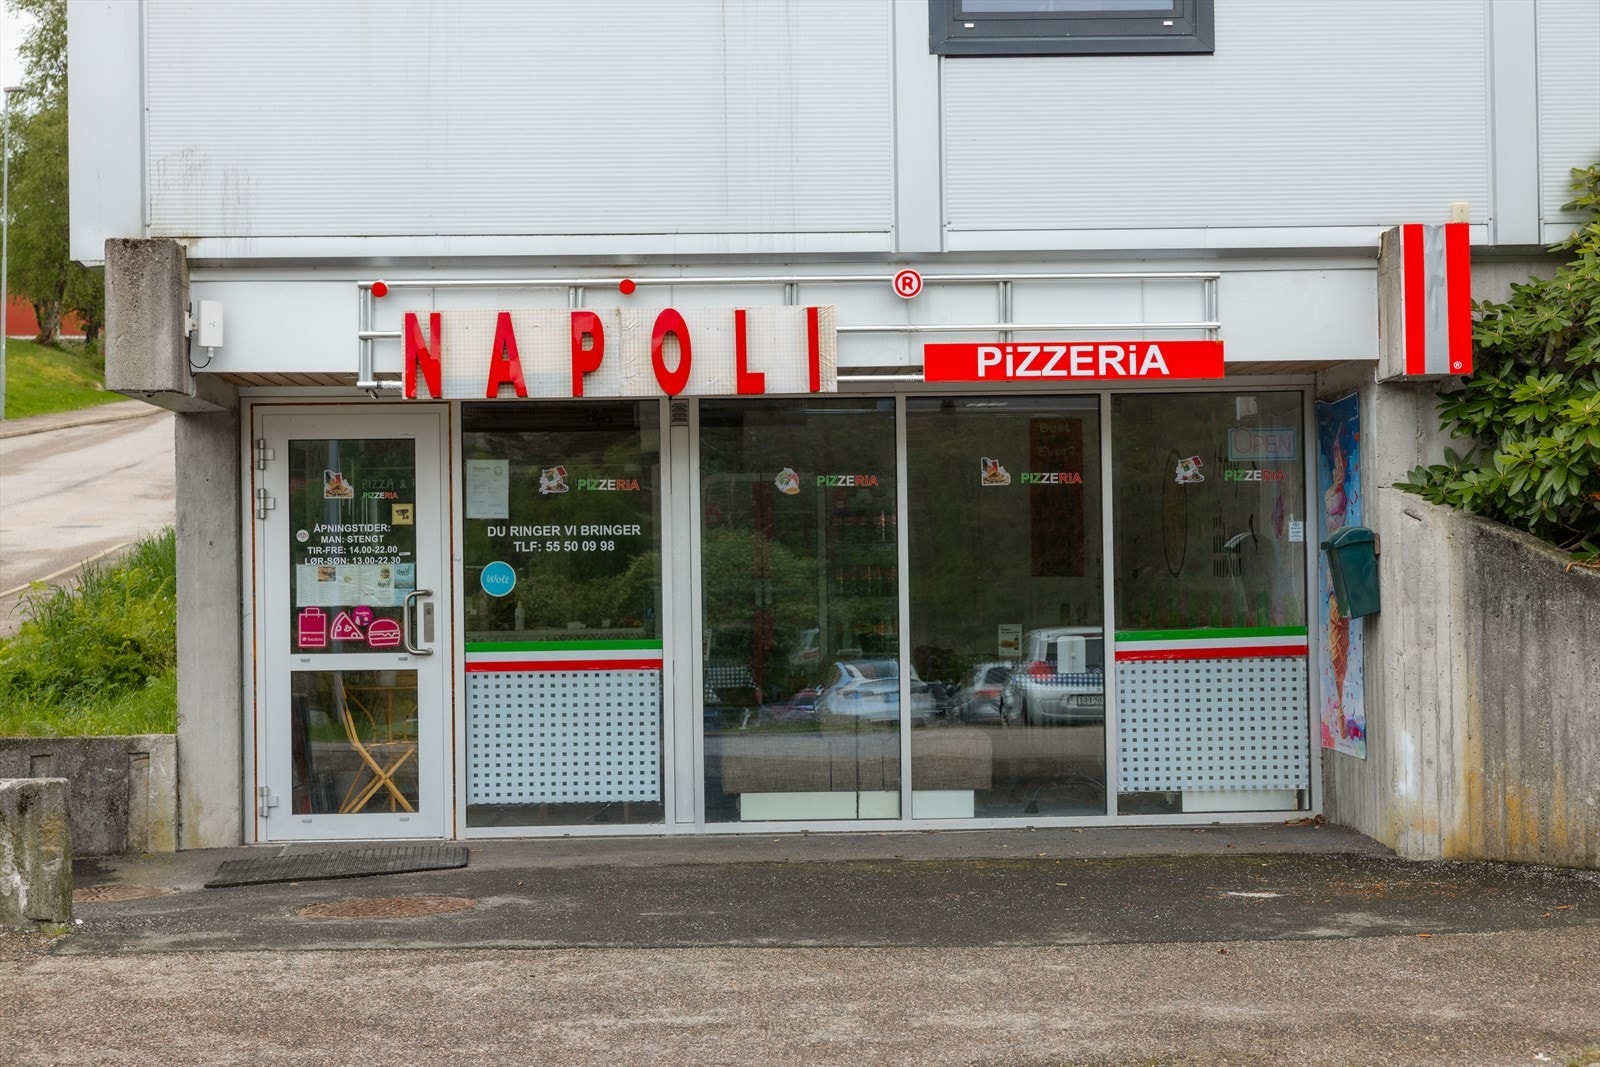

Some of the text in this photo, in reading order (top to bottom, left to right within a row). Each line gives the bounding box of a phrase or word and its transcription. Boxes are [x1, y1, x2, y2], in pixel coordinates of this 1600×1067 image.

[405, 306, 821, 399] NAPOLI
[816, 474, 879, 487] PIZZERIA
[1020, 472, 1083, 484] PIZZERIA
[1224, 469, 1286, 481] PIZZERIA
[362, 478, 394, 490] PIZZA
[577, 479, 640, 491] PIZZERIA
[362, 491, 399, 499] PIZZERIA
[313, 523, 391, 533] ÅPNINGSTIDER:
[487, 524, 642, 537] DU RINGER VI BRINGER
[320, 534, 385, 544] MAN: STENGT
[307, 545, 398, 555] TIR-FRE: 14.00-22.00
[513, 540, 615, 552] TLF: 55 50 09 98
[304, 556, 401, 566] LØR-SØN: 13.00-22.30
[486, 574, 510, 585] Wolt
